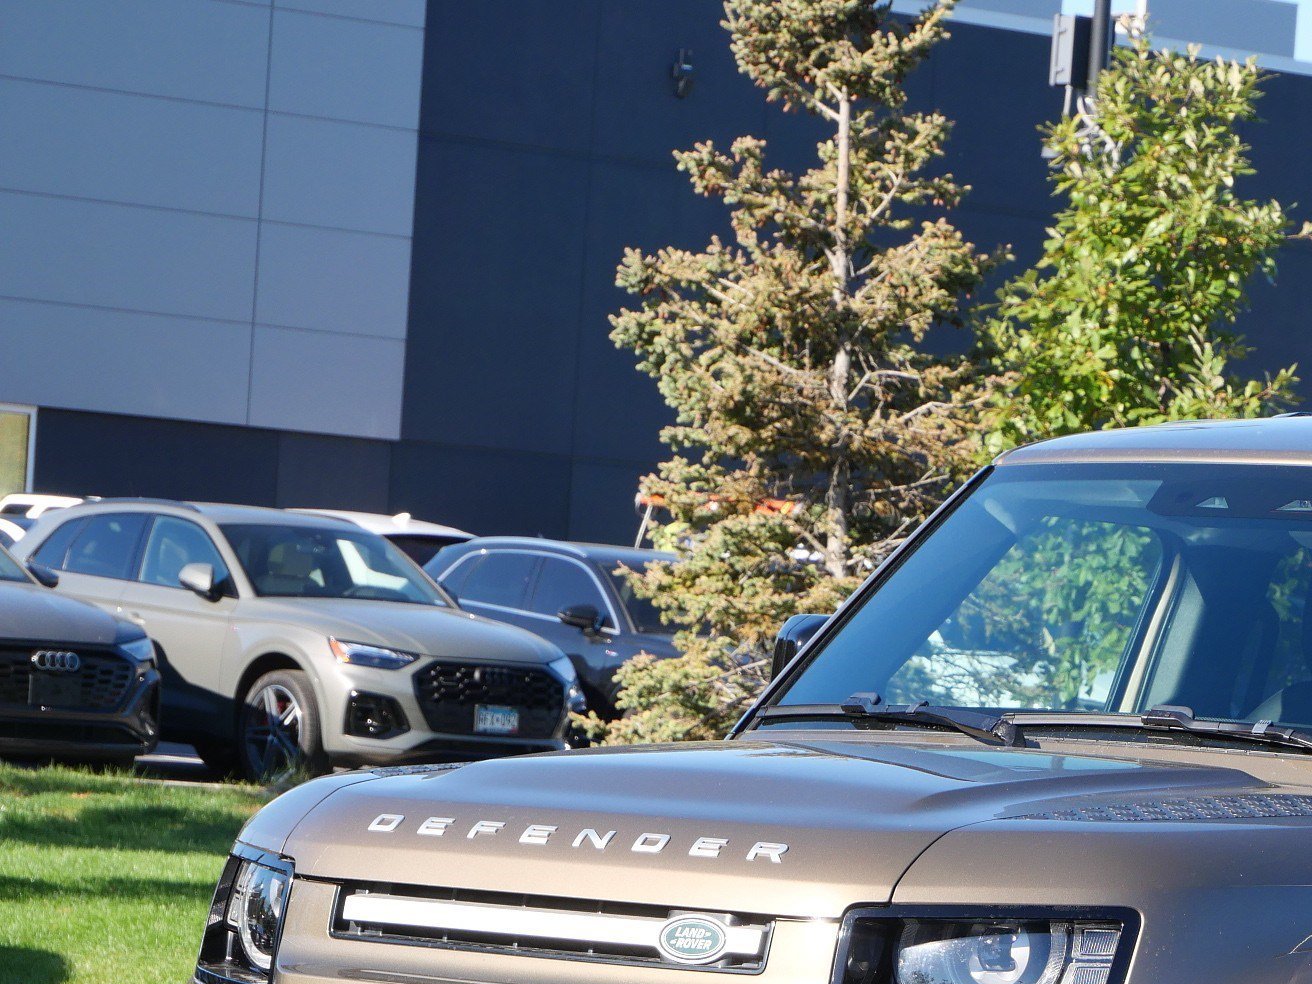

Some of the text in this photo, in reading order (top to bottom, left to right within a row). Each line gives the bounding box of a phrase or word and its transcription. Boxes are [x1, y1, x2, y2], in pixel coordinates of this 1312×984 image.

[367, 813, 790, 864] DEFENDER
[675, 926, 706, 939] LAND
[675, 937, 713, 950] ROVER
